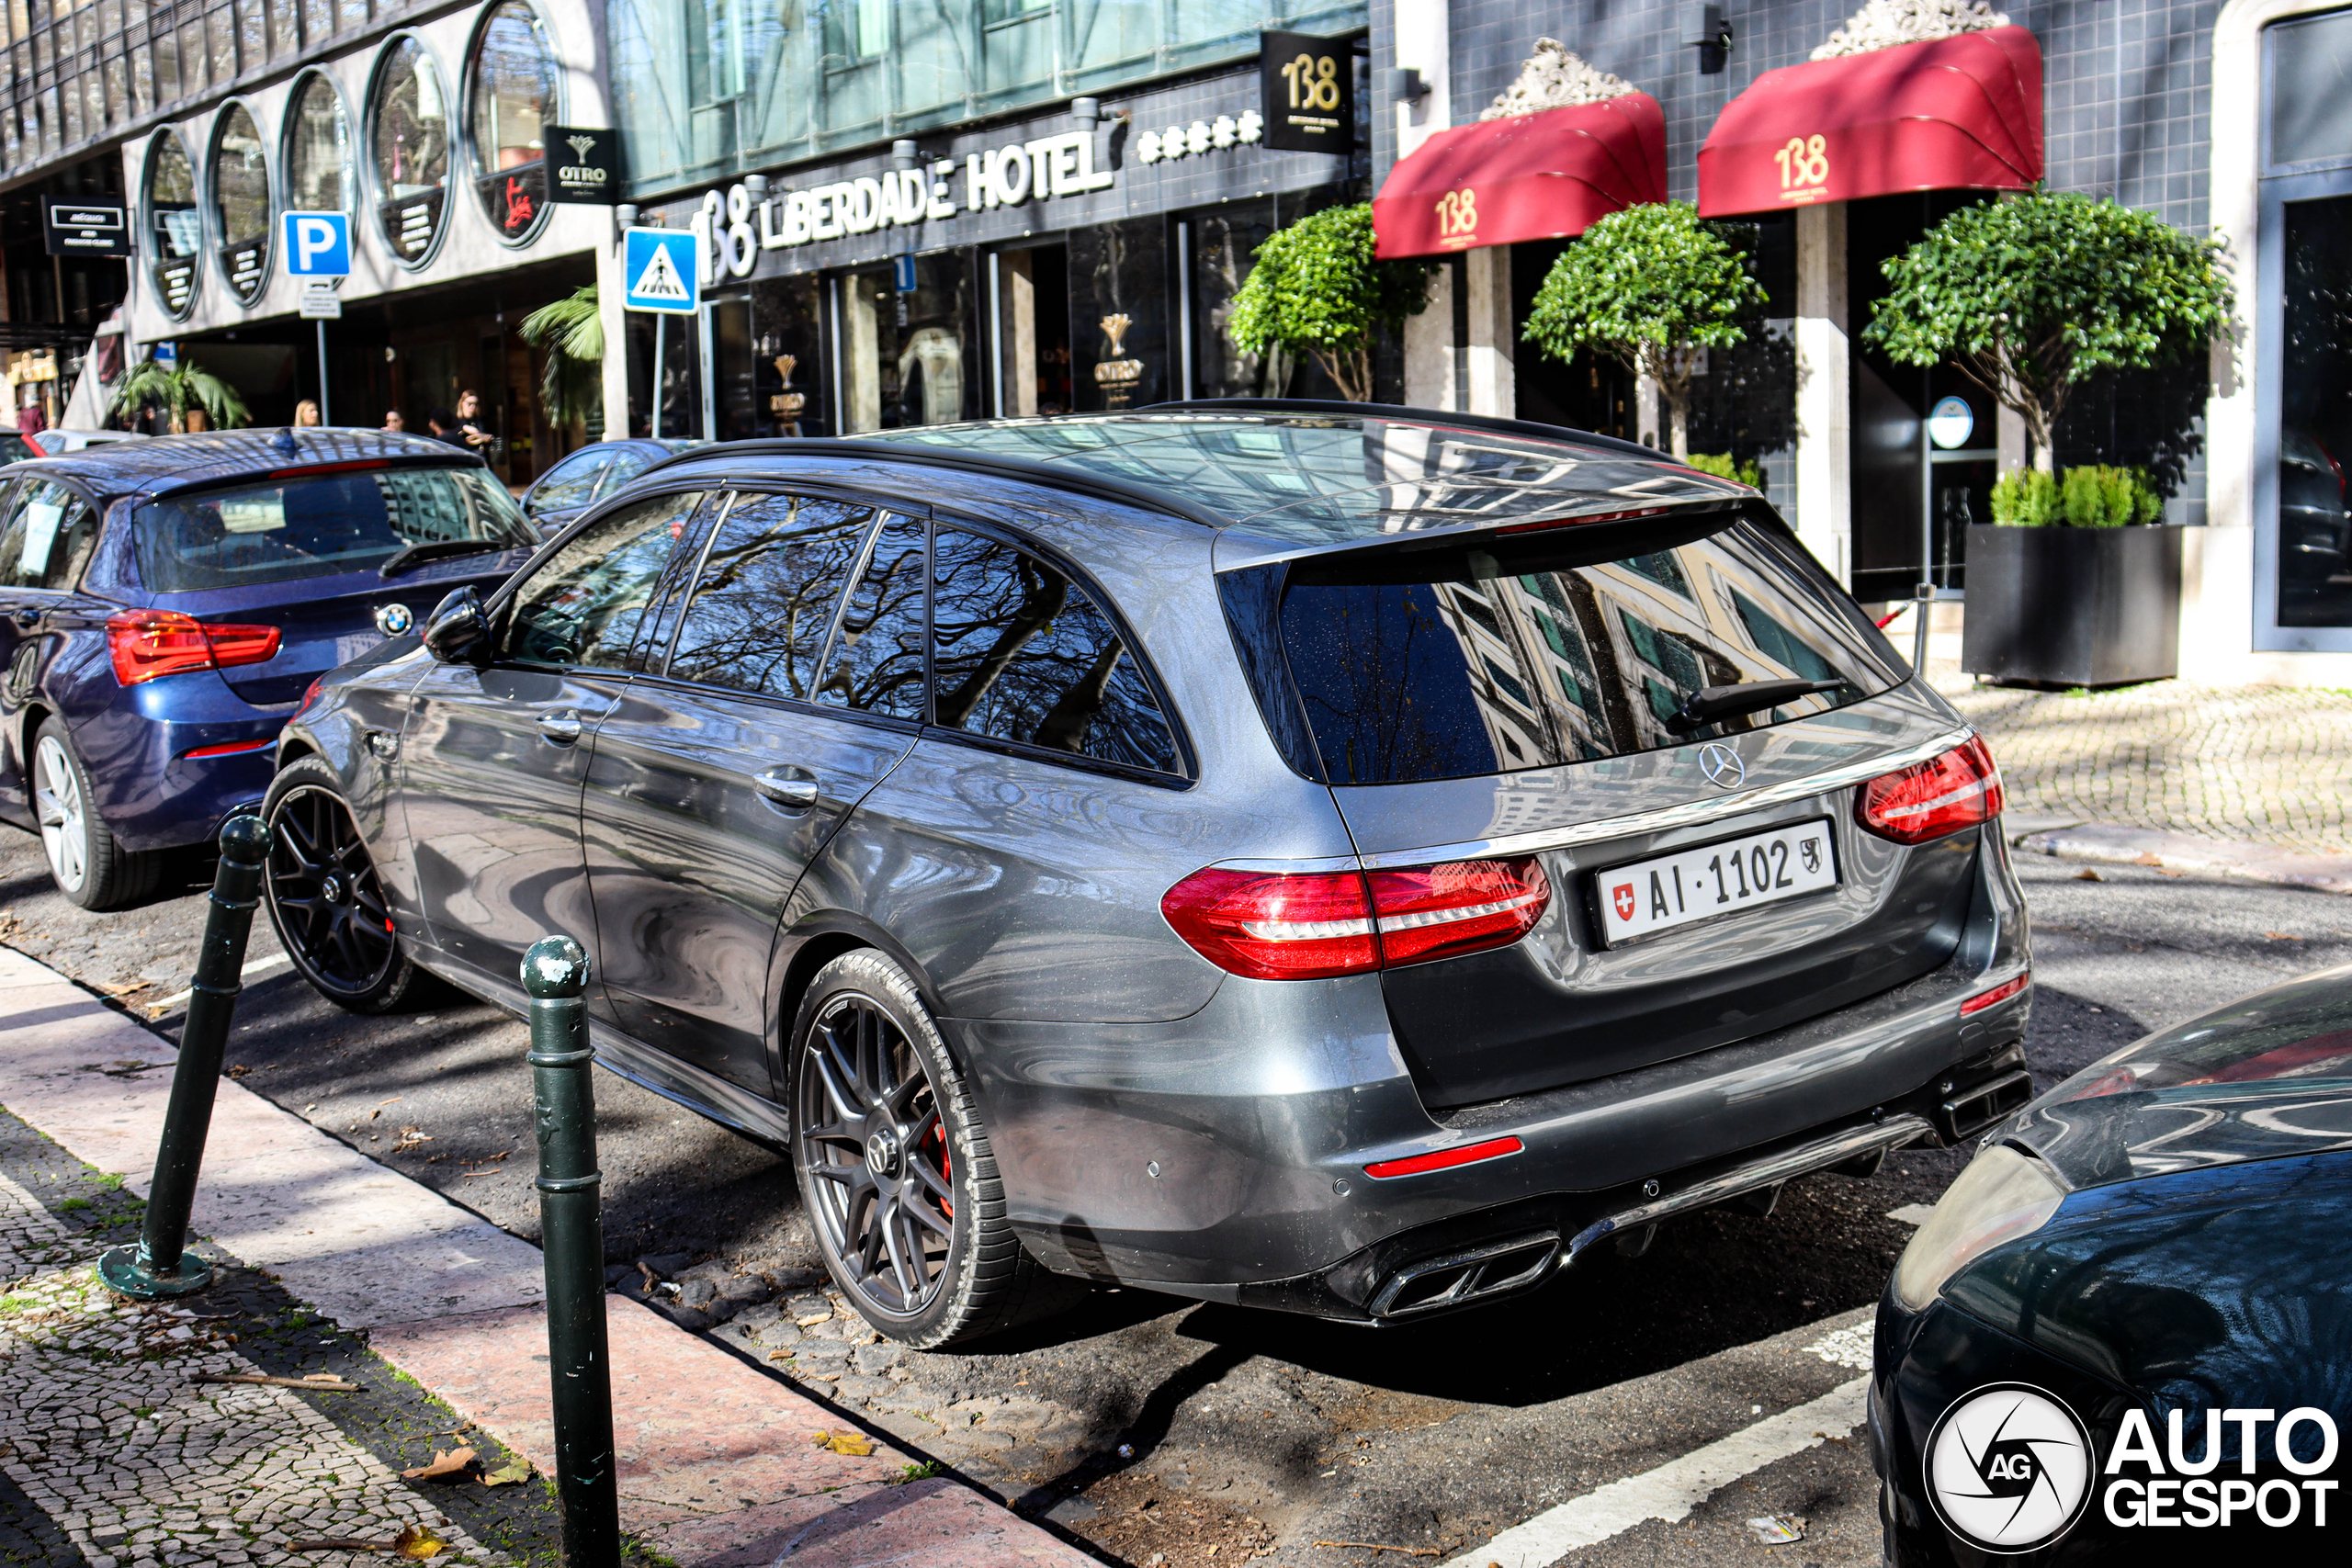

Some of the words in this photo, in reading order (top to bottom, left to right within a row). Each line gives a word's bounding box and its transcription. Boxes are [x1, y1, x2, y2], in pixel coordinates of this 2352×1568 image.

[1282, 53, 1340, 111] 138
[559, 165, 606, 183] OTRO
[1773, 133, 1829, 189] 138
[759, 159, 956, 250] LIBERDADE
[967, 130, 1114, 210] HOTEL
[1435, 187, 1477, 236] 138
[296, 218, 337, 271] P
[1094, 359, 1142, 382] OTRO
